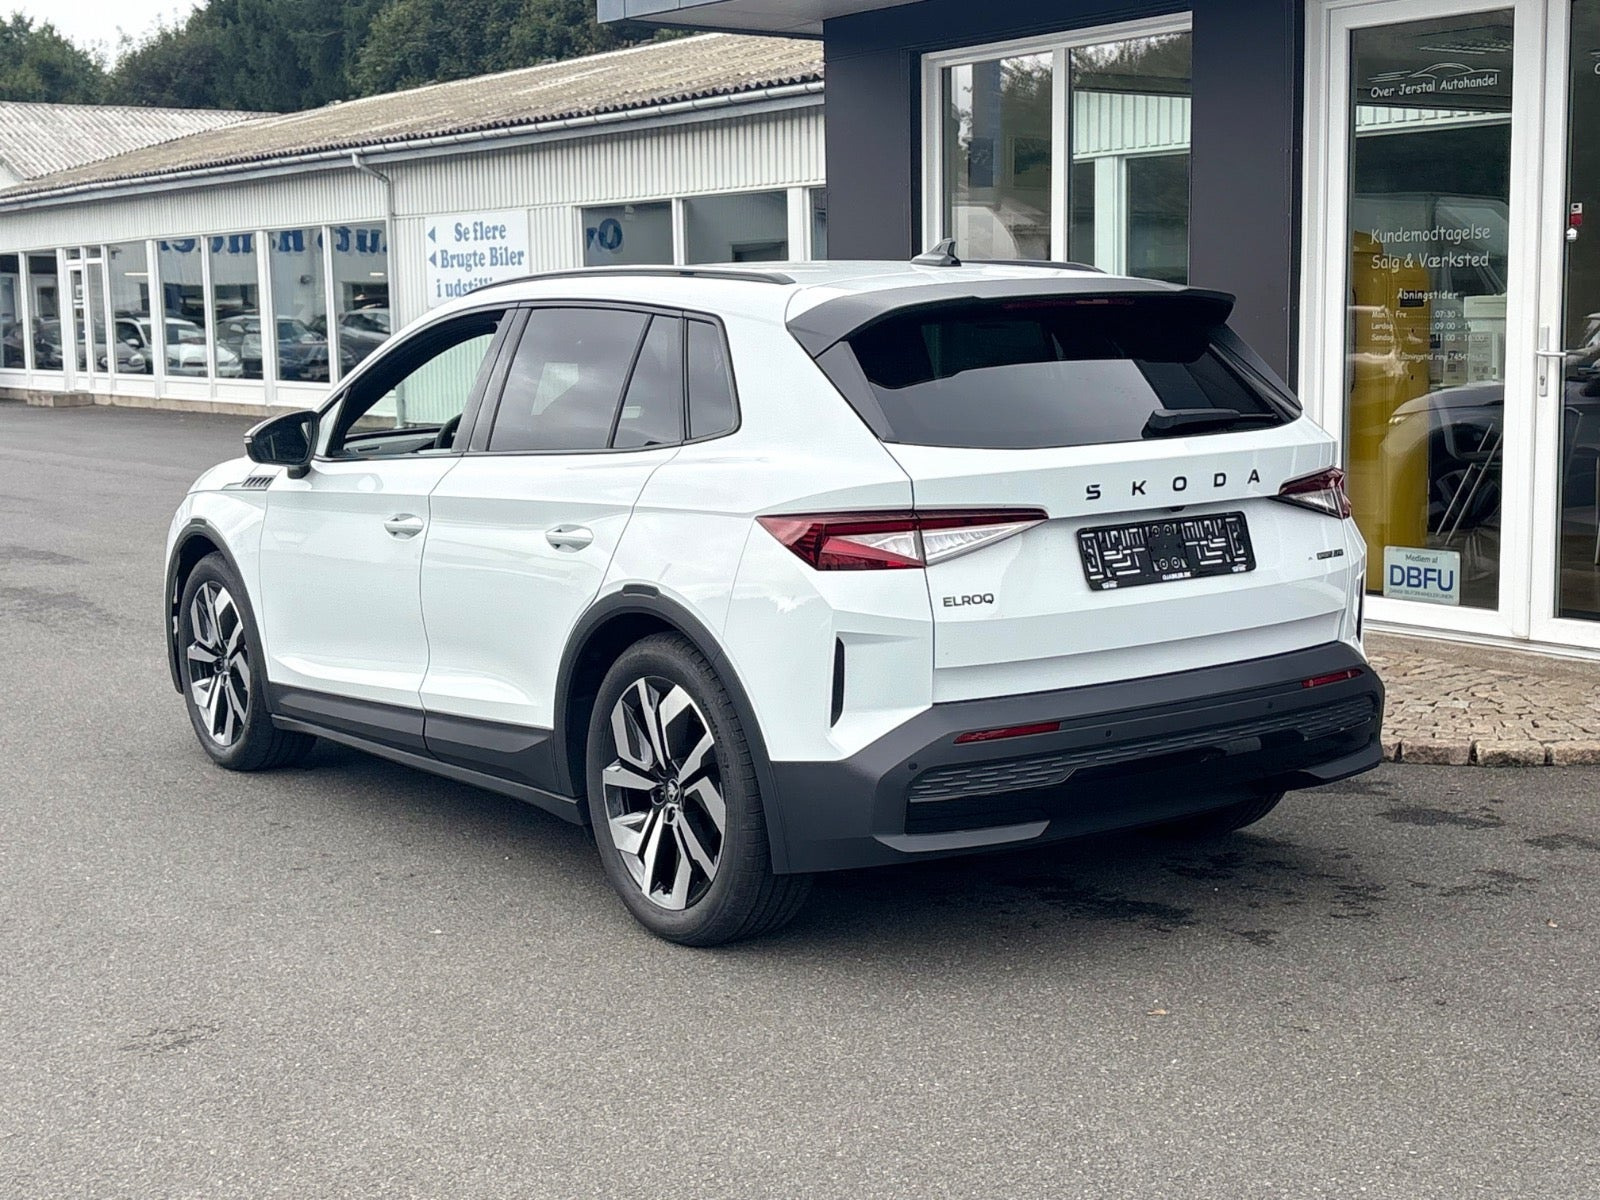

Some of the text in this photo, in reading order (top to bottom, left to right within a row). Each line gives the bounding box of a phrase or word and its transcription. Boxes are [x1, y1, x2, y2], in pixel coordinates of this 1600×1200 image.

[1370, 73, 1498, 98] Over Jerstal Autohandel
[454, 220, 507, 242] Se flere
[1369, 223, 1491, 245] Kundemodtagelse
[440, 246, 525, 272] Brugte Biler
[1371, 250, 1489, 273] Salg & Værksted
[436, 278, 441, 298] i
[1397, 287, 1459, 302] Åbningstider
[1085, 468, 1261, 501] SKODA
[1389, 564, 1454, 591] DBFU
[943, 593, 995, 607] ELROQ
